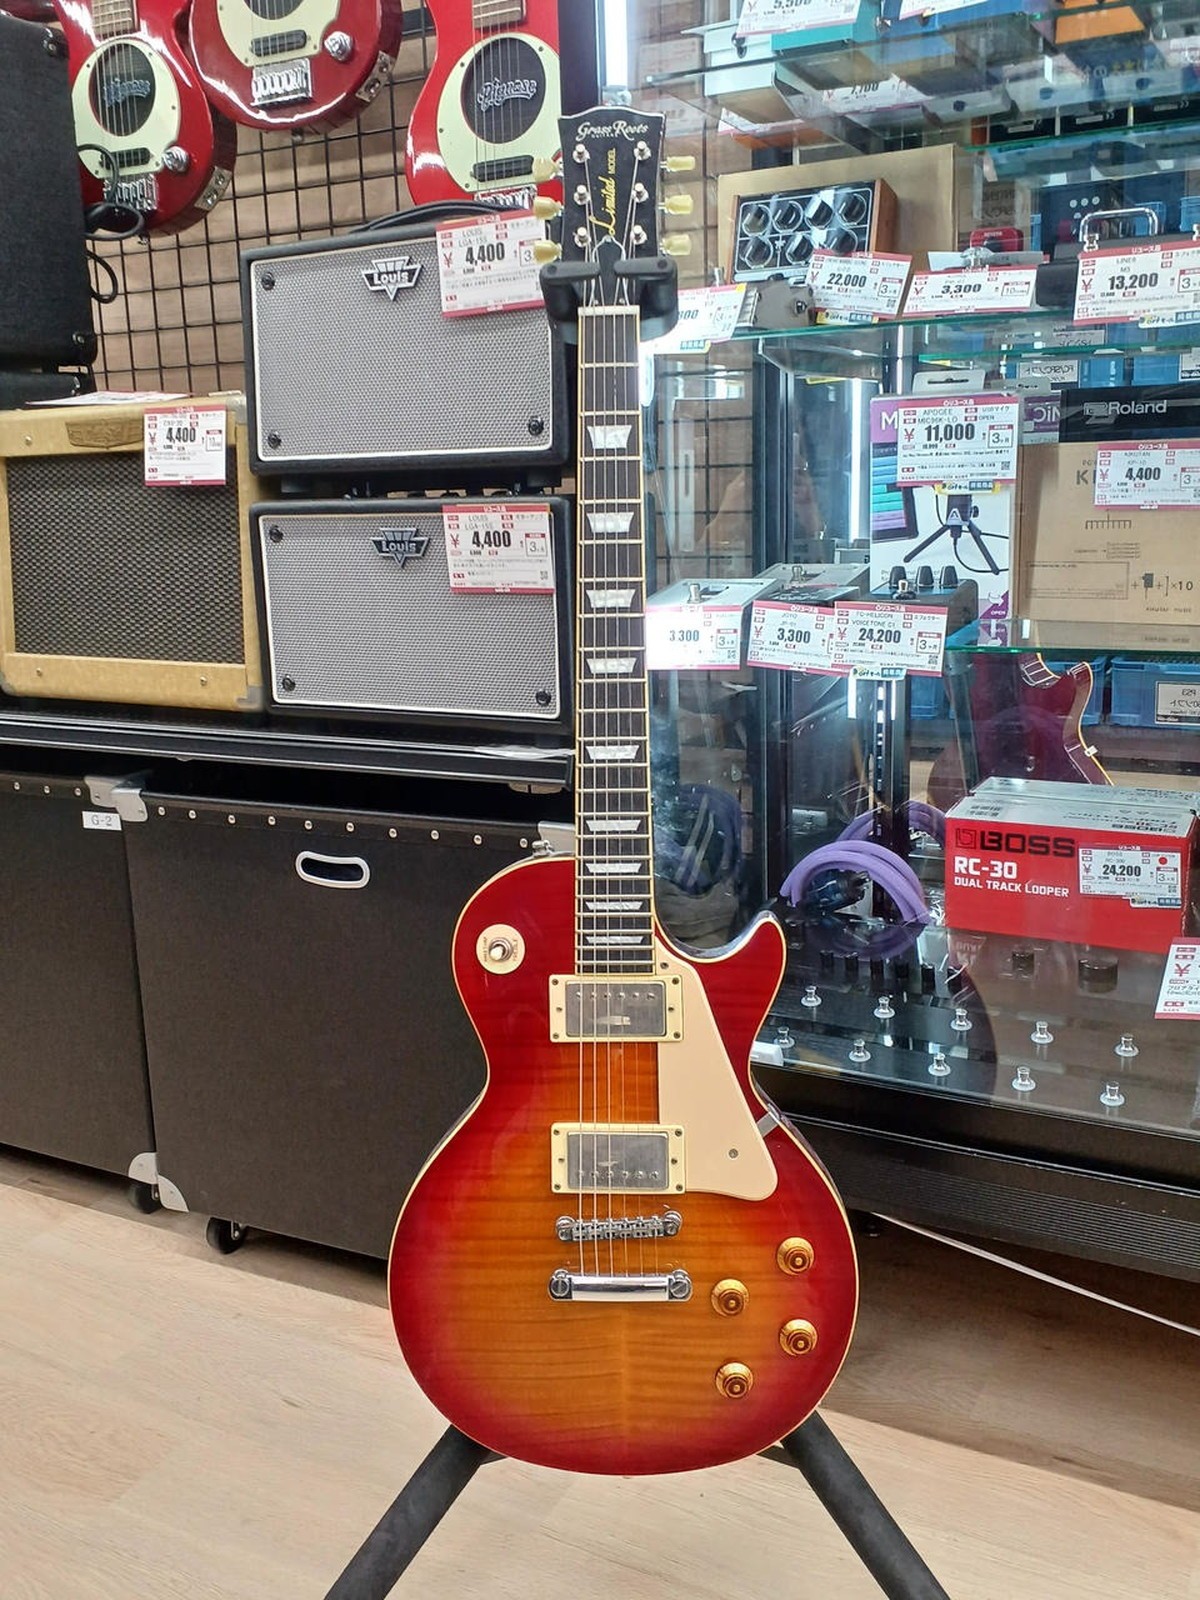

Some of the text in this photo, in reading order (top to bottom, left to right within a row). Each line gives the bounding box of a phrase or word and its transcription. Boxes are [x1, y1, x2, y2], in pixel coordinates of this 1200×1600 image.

[576, 120, 649, 141] Grass Roots
[589, 148, 616, 235] Limited MODEL
[465, 242, 505, 267] 4,400
[374, 270, 409, 285] Louis
[827, 273, 867, 288] 22,000
[1108, 273, 1158, 291] 13,200
[941, 283, 982, 295] 3,300
[1108, 400, 1167, 415] Roland
[166, 427, 196, 444] 4,400
[924, 423, 976, 443] 11,000
[1125, 467, 1161, 482] 4,400
[382, 541, 417, 552] Louis
[472, 530, 511, 550] 4,400
[670, 630, 700, 642] 3300
[777, 628, 811, 644] 3,300
[858, 628, 901, 644] 24,200
[91, 815, 112, 826] G-2
[980, 831, 1075, 857] BOSS
[954, 856, 1017, 880] RC-30
[1102, 864, 1141, 877] 24,200
[954, 877, 983, 889] DUAL
[986, 880, 1022, 893] TRACK
[1025, 884, 1070, 898] LOOPER
